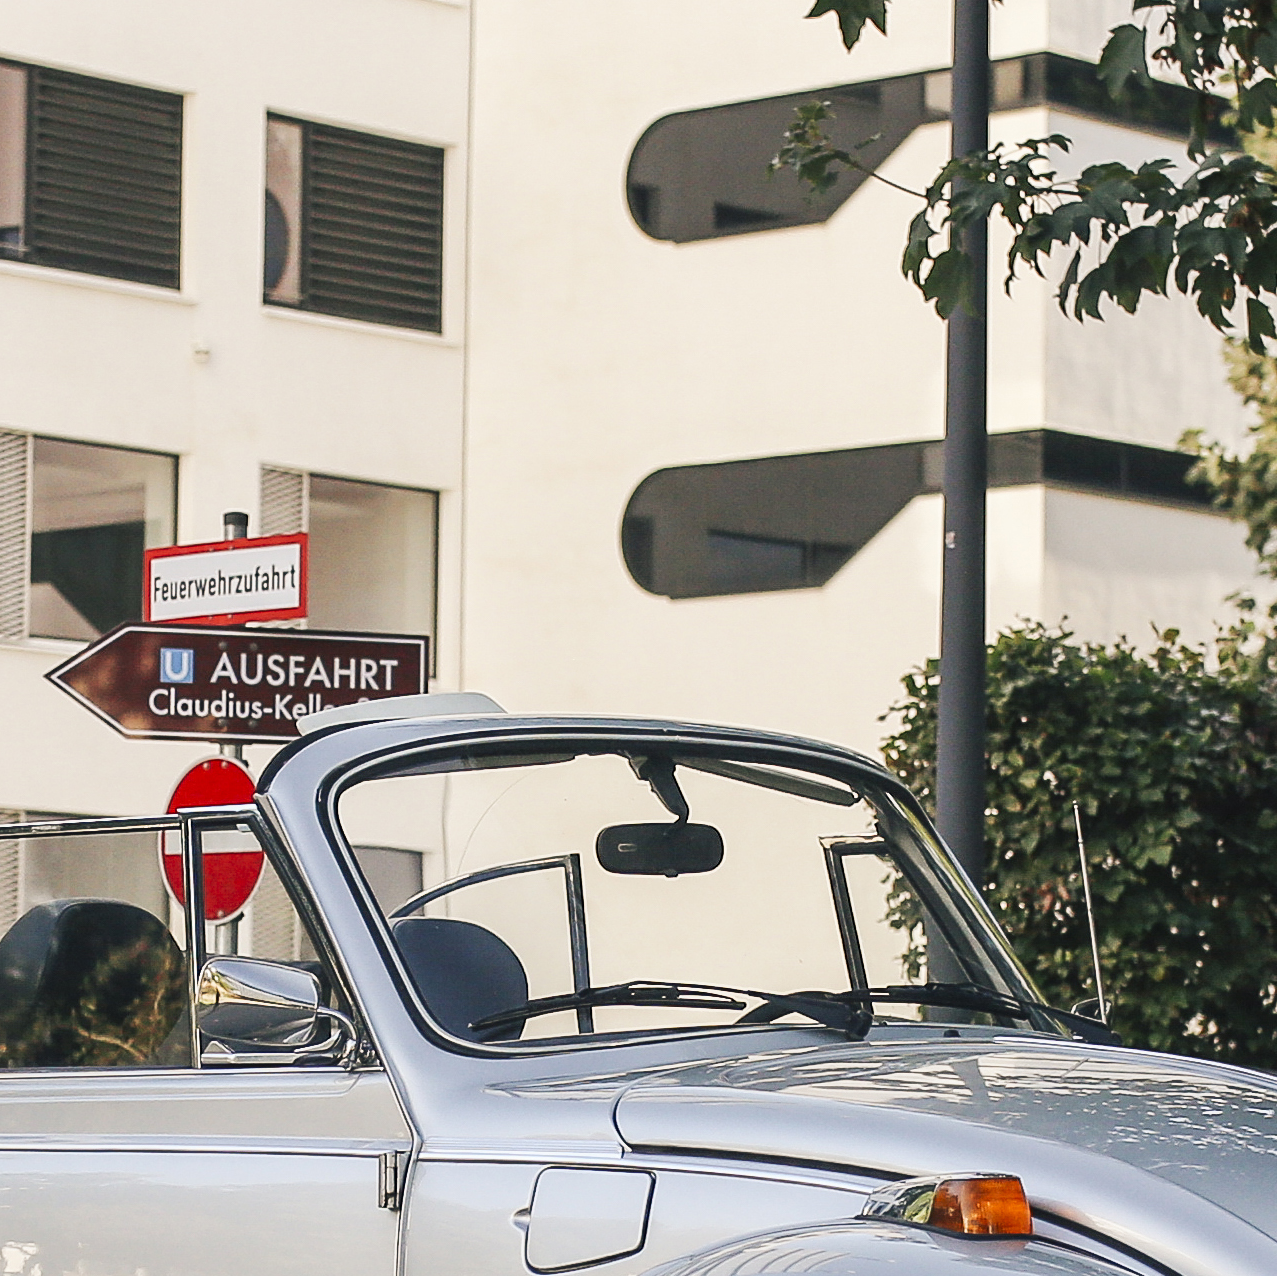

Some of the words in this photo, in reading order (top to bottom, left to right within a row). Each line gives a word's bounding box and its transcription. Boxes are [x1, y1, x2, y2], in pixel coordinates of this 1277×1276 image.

[154, 564, 296, 602] Feuerwehrzufahrt
[165, 650, 189, 681] U
[210, 651, 399, 691] AUSFAHRT
